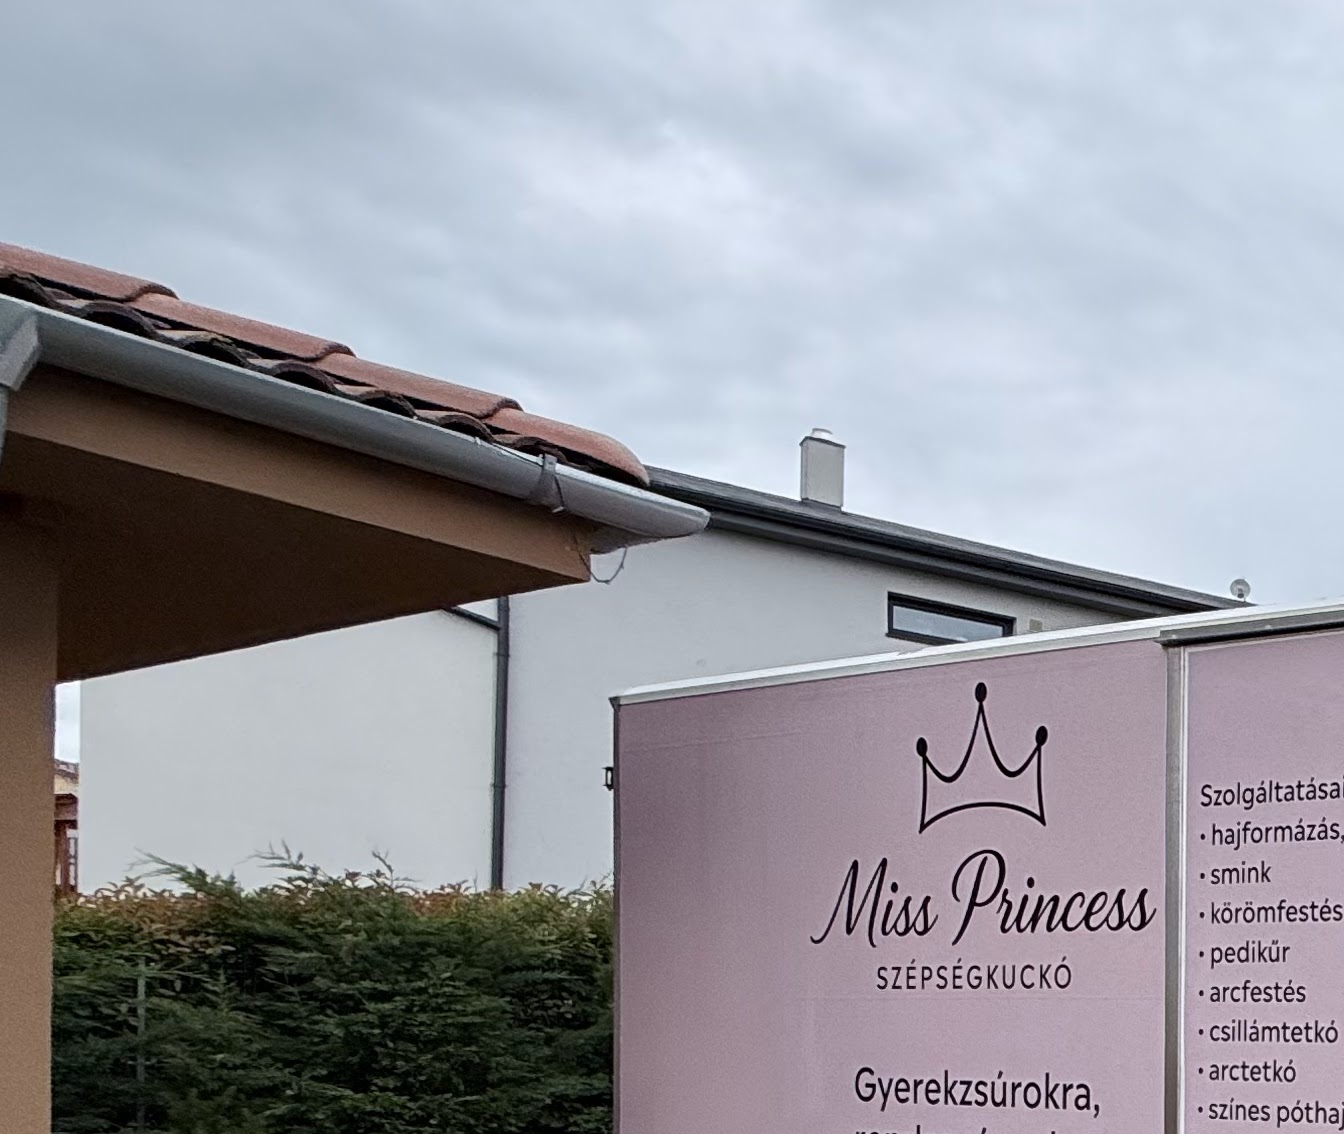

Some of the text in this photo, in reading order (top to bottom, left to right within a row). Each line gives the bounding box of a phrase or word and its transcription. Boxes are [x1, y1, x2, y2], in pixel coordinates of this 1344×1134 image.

[1210, 860, 1272, 885] smink
[809, 848, 1158, 949] Miss Princess
[1210, 897, 1344, 925] körömfestés
[876, 955, 1072, 991] SZÉPSÉGKUCKÓ
[1209, 979, 1307, 1003] arcfestés
[1209, 1018, 1339, 1044] csillámtetkó
[1208, 1058, 1297, 1084] arctetkó
[854, 1066, 1100, 1119] Gyerekzsúrokra,
[1208, 1097, 1271, 1122] színes
